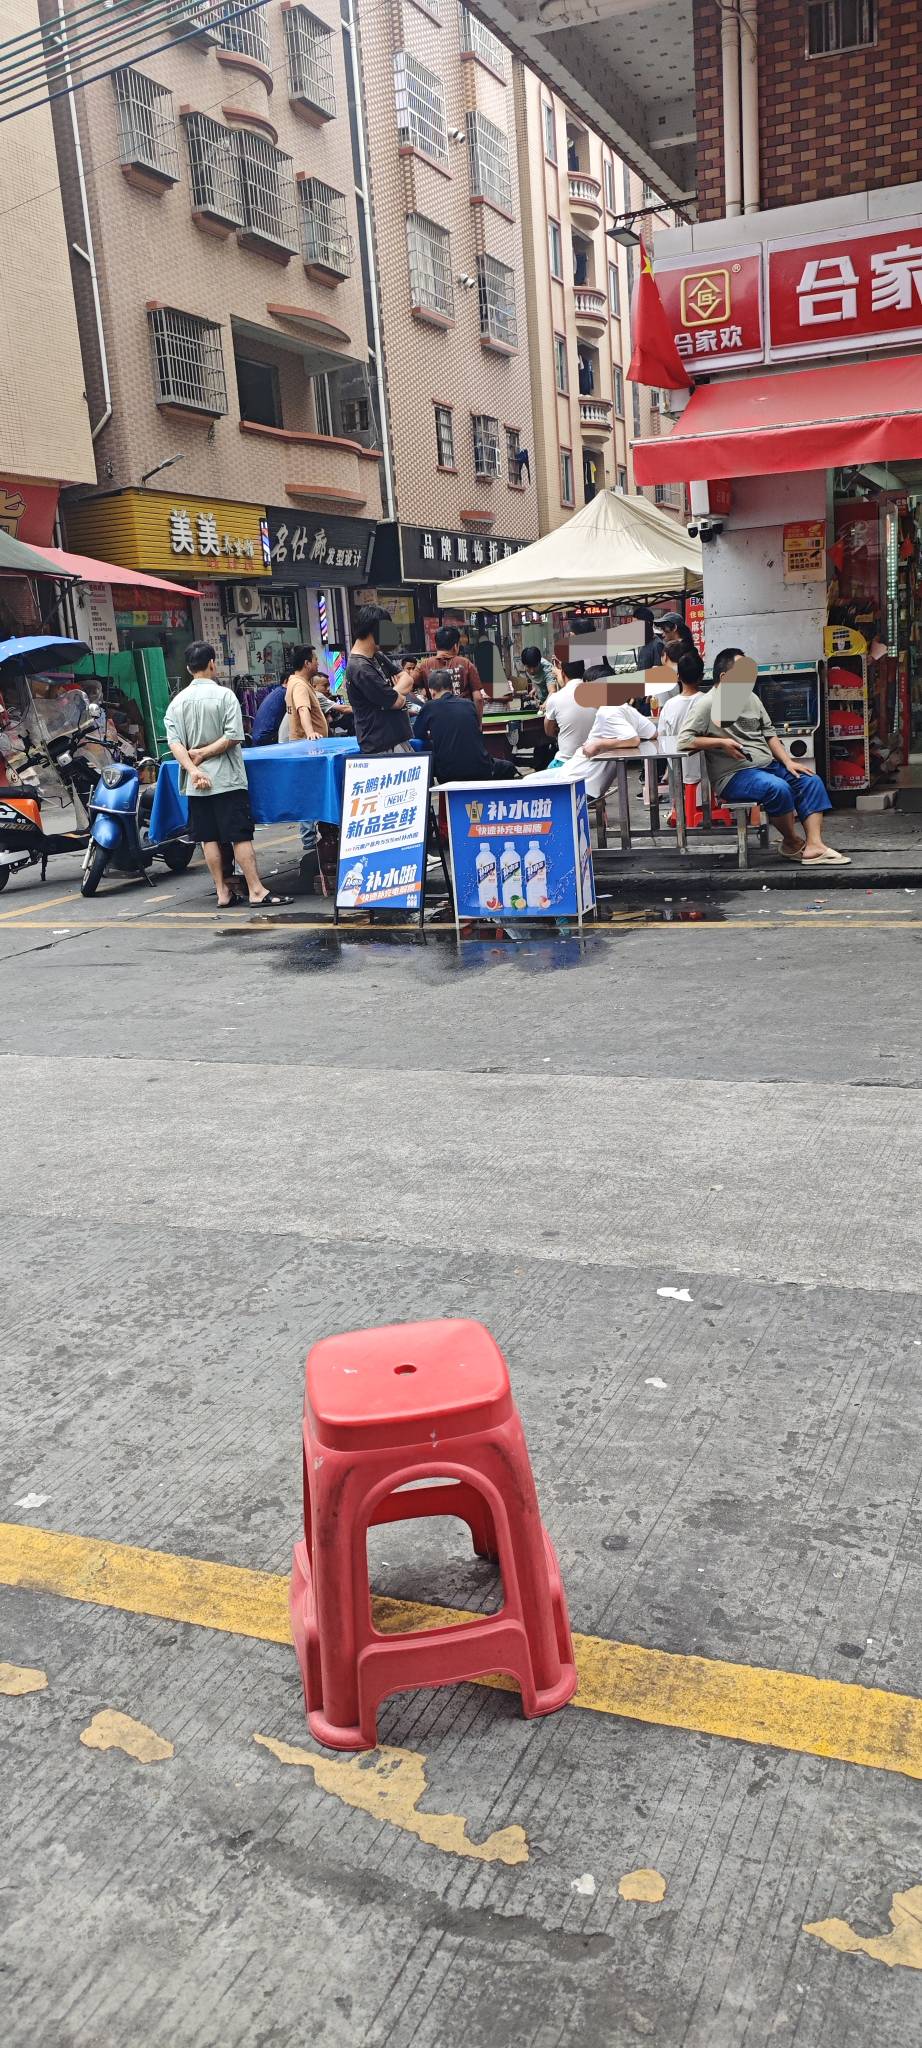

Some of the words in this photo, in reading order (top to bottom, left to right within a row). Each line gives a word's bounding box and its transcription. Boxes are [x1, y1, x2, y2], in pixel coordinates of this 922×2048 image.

[796, 244, 922, 326] 合家
[674, 325, 742, 356] 合家欢
[170, 509, 220, 557] 美美
[270, 523, 328, 565] 名仕廊
[326, 547, 362, 568] 发型设计
[351, 766, 421, 797] 东鹏补水啦
[350, 795, 378, 817] 1元
[387, 789, 408, 806] NEW!
[488, 799, 552, 821] 补水啦
[346, 806, 418, 840] 新品尝鲜
[366, 864, 418, 892] 补水啦
